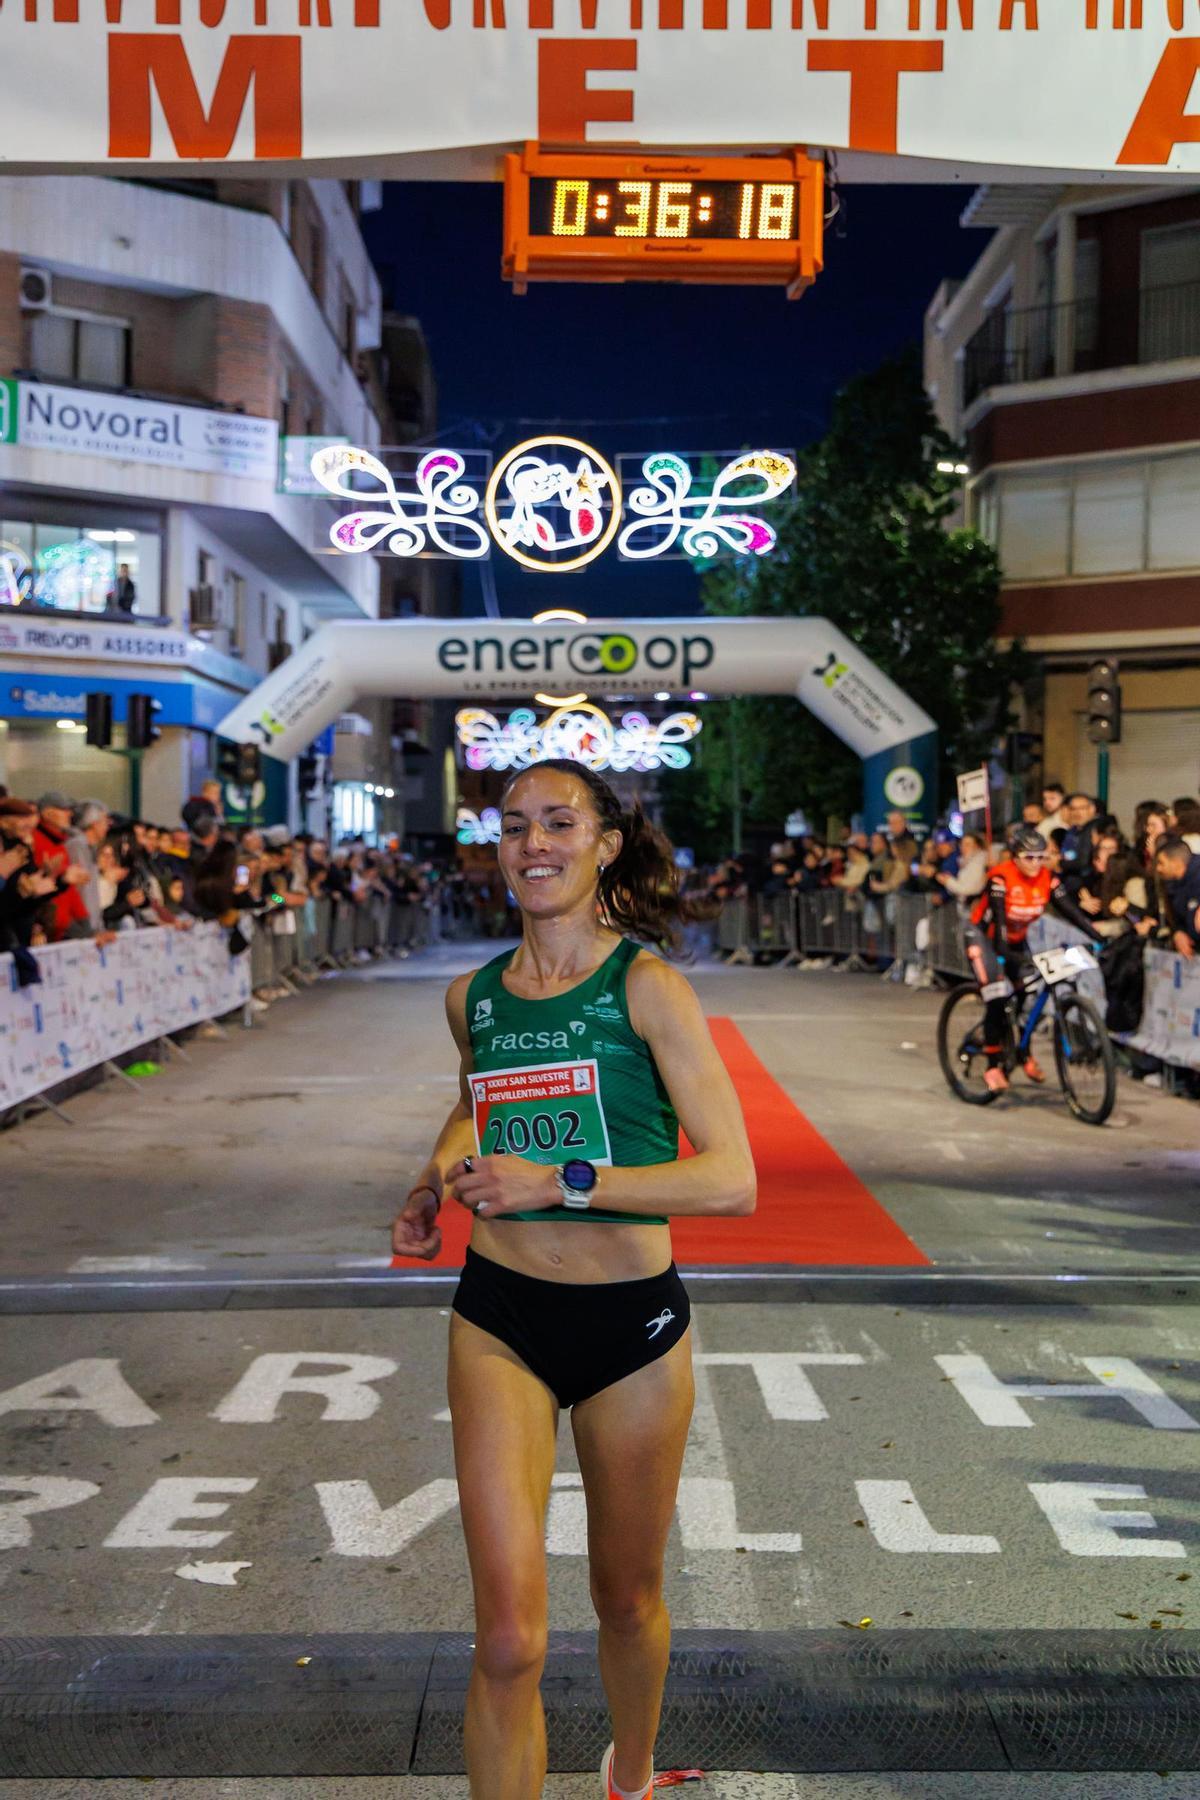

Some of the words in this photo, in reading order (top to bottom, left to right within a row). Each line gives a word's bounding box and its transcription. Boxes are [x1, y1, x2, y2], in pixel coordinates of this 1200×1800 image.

[27, 391, 184, 447] Novoral
[103, 636, 187, 658] ASESORES
[437, 632, 715, 687] enercoop
[23, 688, 87, 714] Sabad
[509, 1074, 527, 1086] SAN
[528, 1071, 570, 1084] SILVESTRE
[488, 1087, 547, 1102] CREVILLENTINA
[549, 1084, 571, 1096] 2025
[489, 1109, 586, 1155] 2002
